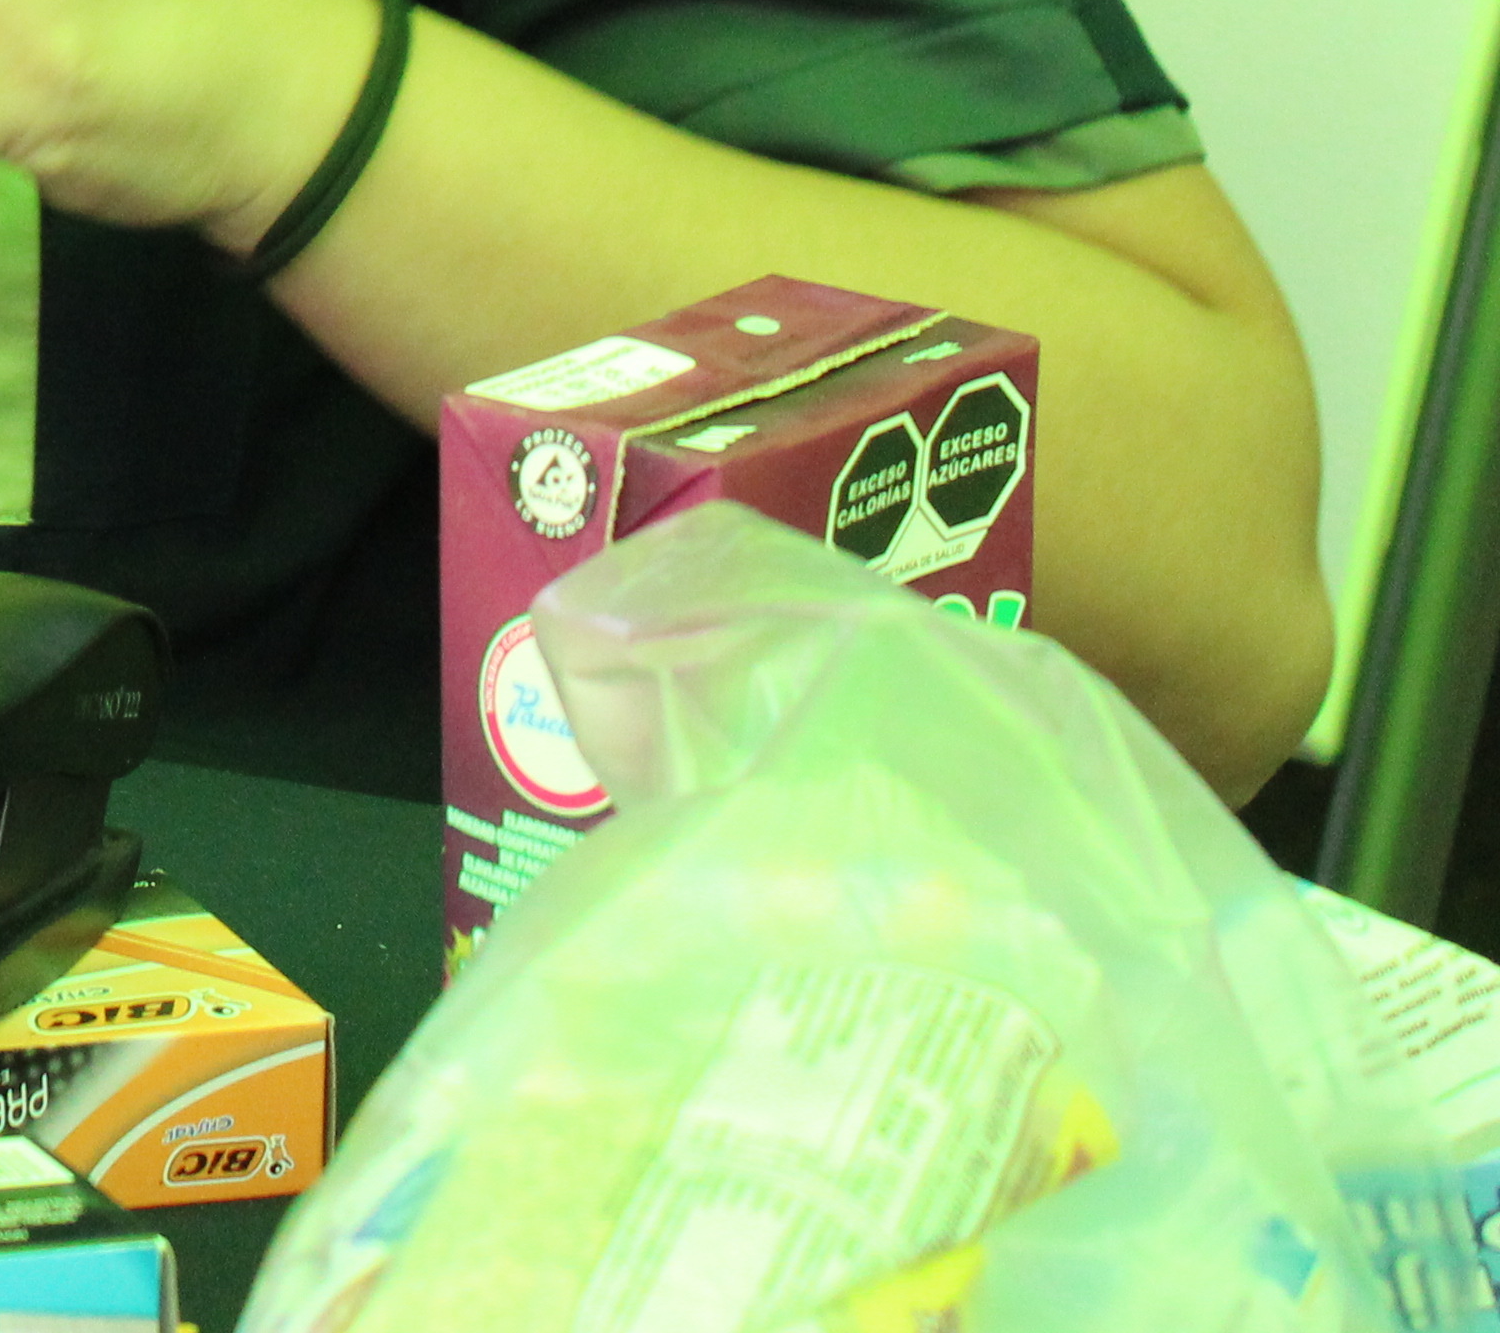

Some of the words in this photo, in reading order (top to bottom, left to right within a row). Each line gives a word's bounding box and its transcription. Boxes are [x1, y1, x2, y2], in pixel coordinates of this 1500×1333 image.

[522, 428, 591, 464] PROTEGE
[939, 422, 1008, 462] EXCESO
[848, 460, 906, 501] EXCESO
[928, 445, 1017, 489] AZÚCARES
[515, 498, 533, 523] LO
[535, 513, 585, 539] BUENO
[836, 480, 912, 529] CALORÍAS
[935, 543, 965, 562] SALUD
[506, 681, 576, 739] Pascu
[46, 999, 176, 1031] BIC
[174, 1147, 258, 1178] BIC
